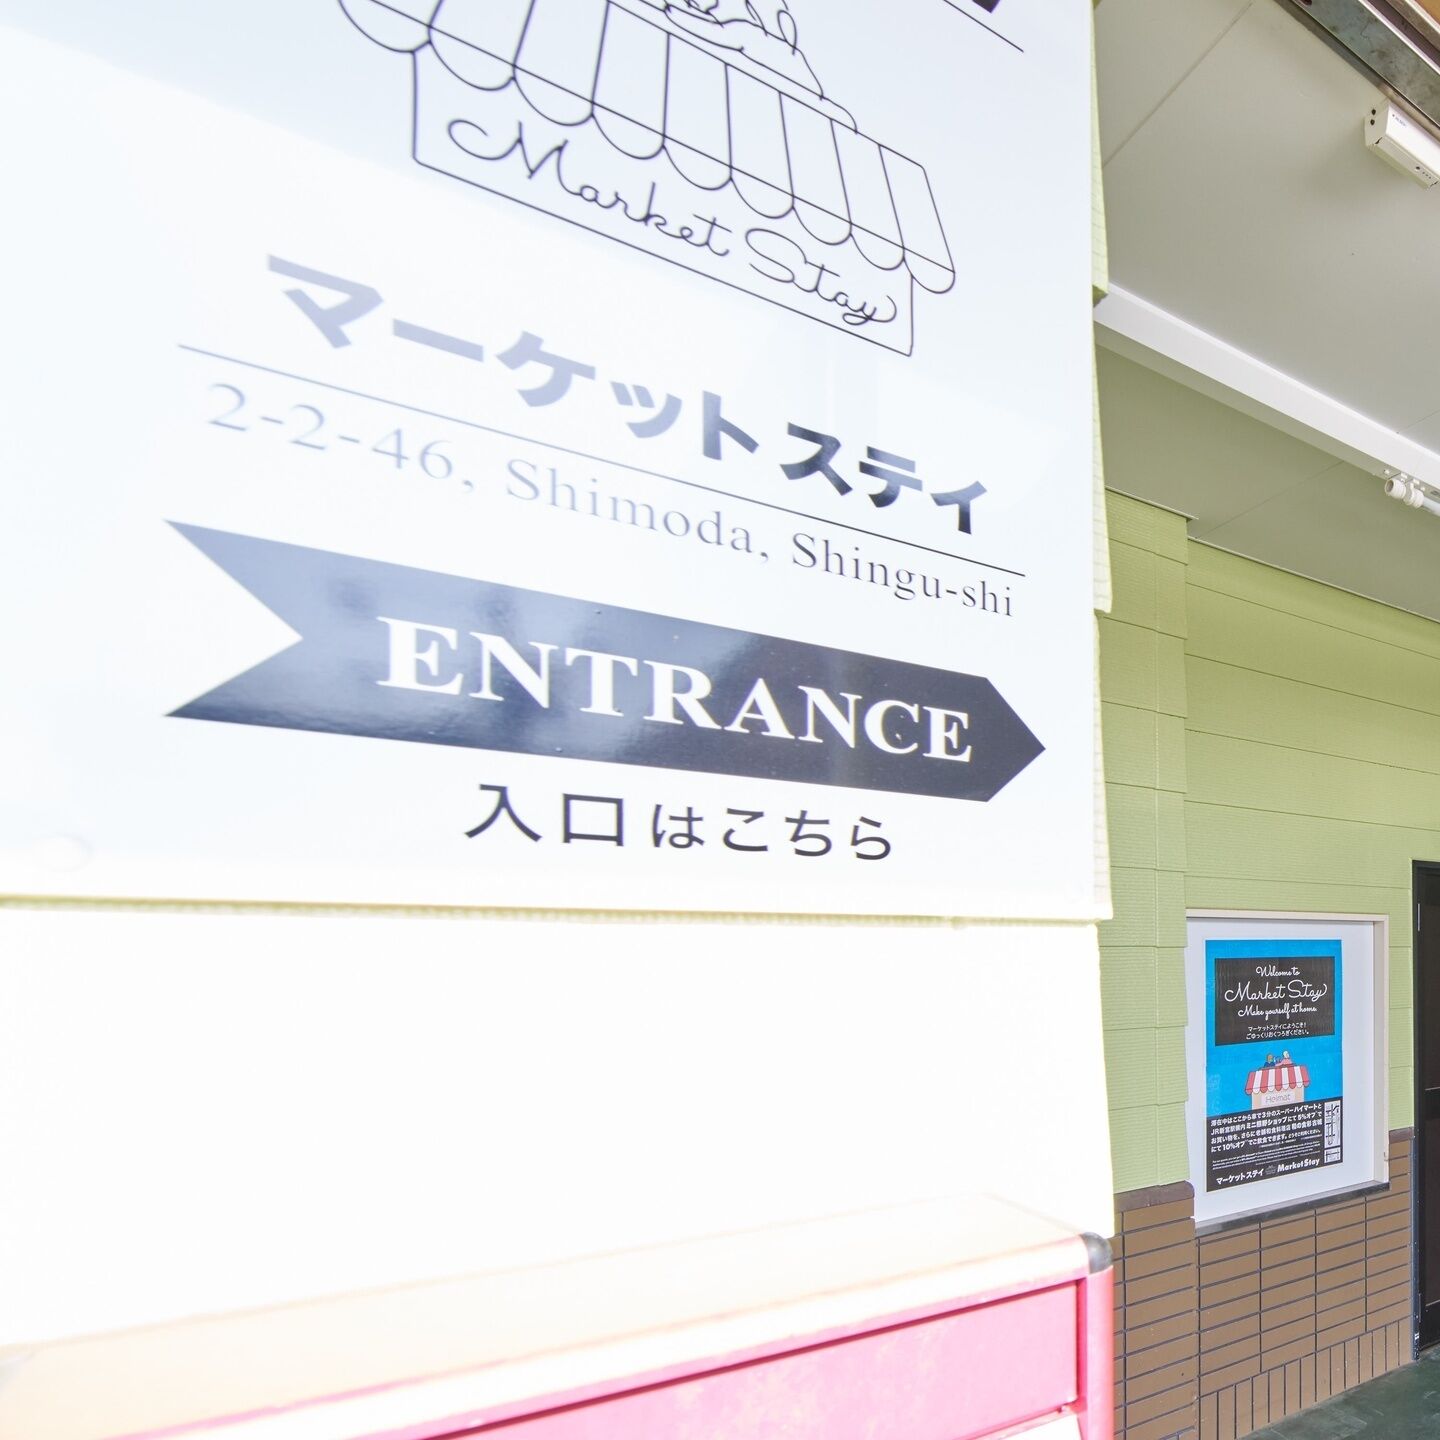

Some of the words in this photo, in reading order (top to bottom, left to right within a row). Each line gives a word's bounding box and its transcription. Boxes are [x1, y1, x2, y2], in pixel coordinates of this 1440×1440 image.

[447, 119, 732, 256] Market
[745, 228, 897, 326] Stay
[266, 253, 988, 536] マーケットステイ
[207, 382, 473, 490] 2-2-46,
[505, 457, 769, 563] Shimoda,
[792, 531, 1014, 617] Shingu-shi
[376, 616, 974, 763] ENTRANCE
[464, 782, 893, 862] 入口はこちら
[1224, 981, 1286, 1002] Market
[1287, 979, 1328, 1002] Stay
[1255, 964, 1291, 977] Welcome
[1291, 966, 1300, 976] to
[1237, 1004, 1264, 1017] Make
[1264, 1002, 1291, 1021] yourself
[1216, 1168, 1264, 1184] マーケットステイ
